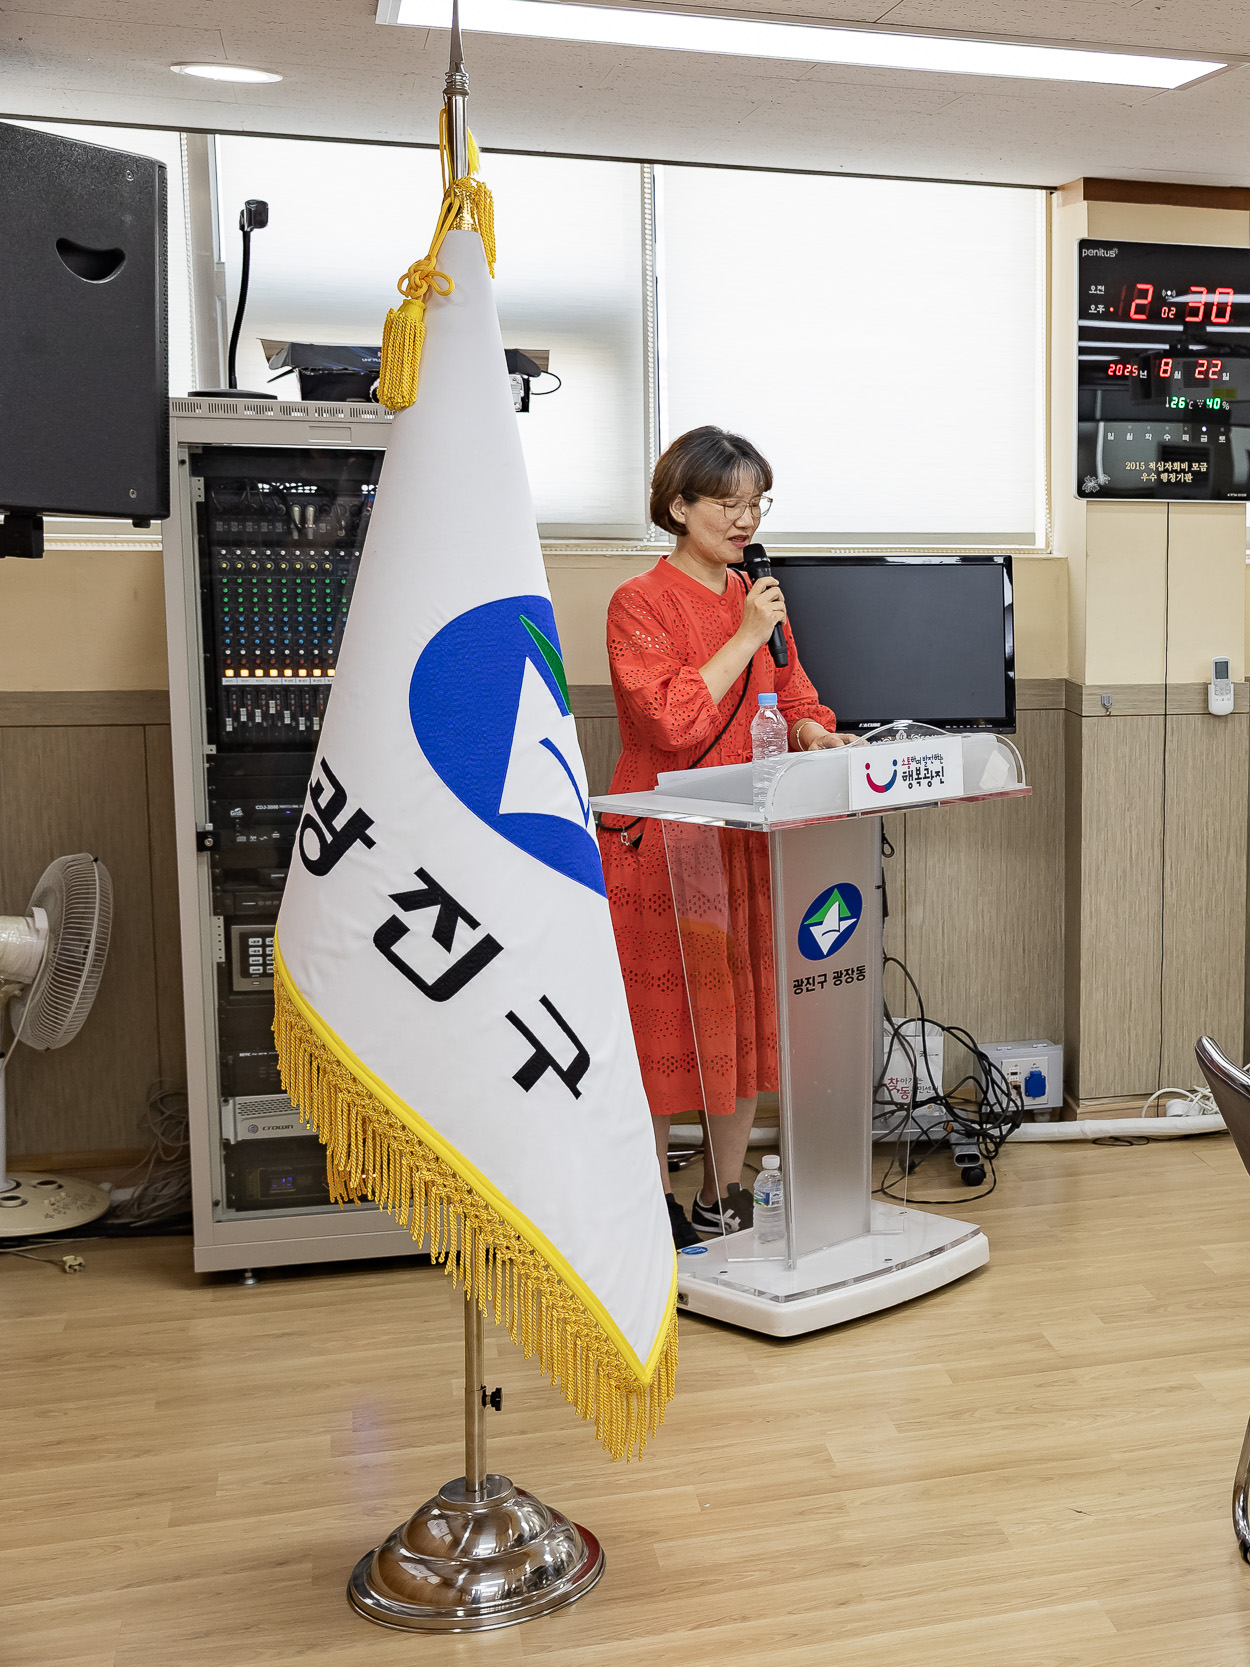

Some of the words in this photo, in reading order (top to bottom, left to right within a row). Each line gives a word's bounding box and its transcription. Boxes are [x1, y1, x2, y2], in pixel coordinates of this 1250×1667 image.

[1082, 248, 1116, 257] penitus
[1088, 285, 1105, 294] 오전
[1161, 306, 1176, 319] 02
[1185, 286, 1234, 323] 30
[1125, 462, 1145, 470] 2015
[1148, 461, 1188, 472] 적십자회비
[1191, 462, 1208, 472] 모금
[1140, 473, 1157, 482] 우수
[1160, 473, 1193, 483] 행정기관
[901, 755, 922, 770] 소통하며
[922, 753, 944, 767] 발전하는
[901, 766, 945, 790] 행복광진
[299, 757, 590, 1099] 광진구
[792, 973, 828, 995] 광진구
[832, 965, 866, 987] 광장동
